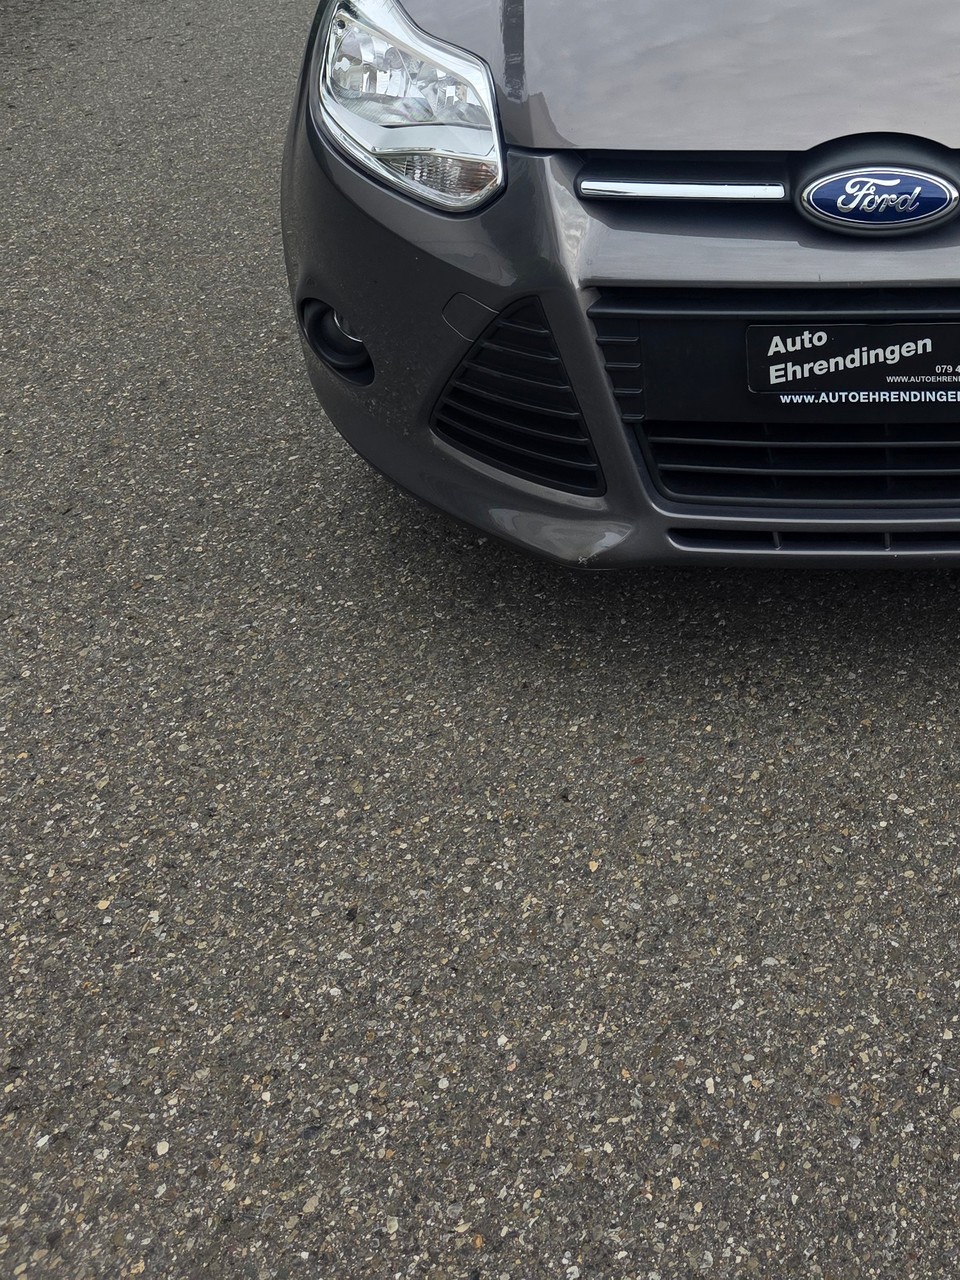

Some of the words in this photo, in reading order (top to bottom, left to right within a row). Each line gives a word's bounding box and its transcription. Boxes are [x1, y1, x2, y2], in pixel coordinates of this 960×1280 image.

[836, 177, 922, 213] Ford
[767, 330, 828, 356] Auto
[769, 337, 933, 385] Ehrendingen
[935, 365, 953, 374] 079
